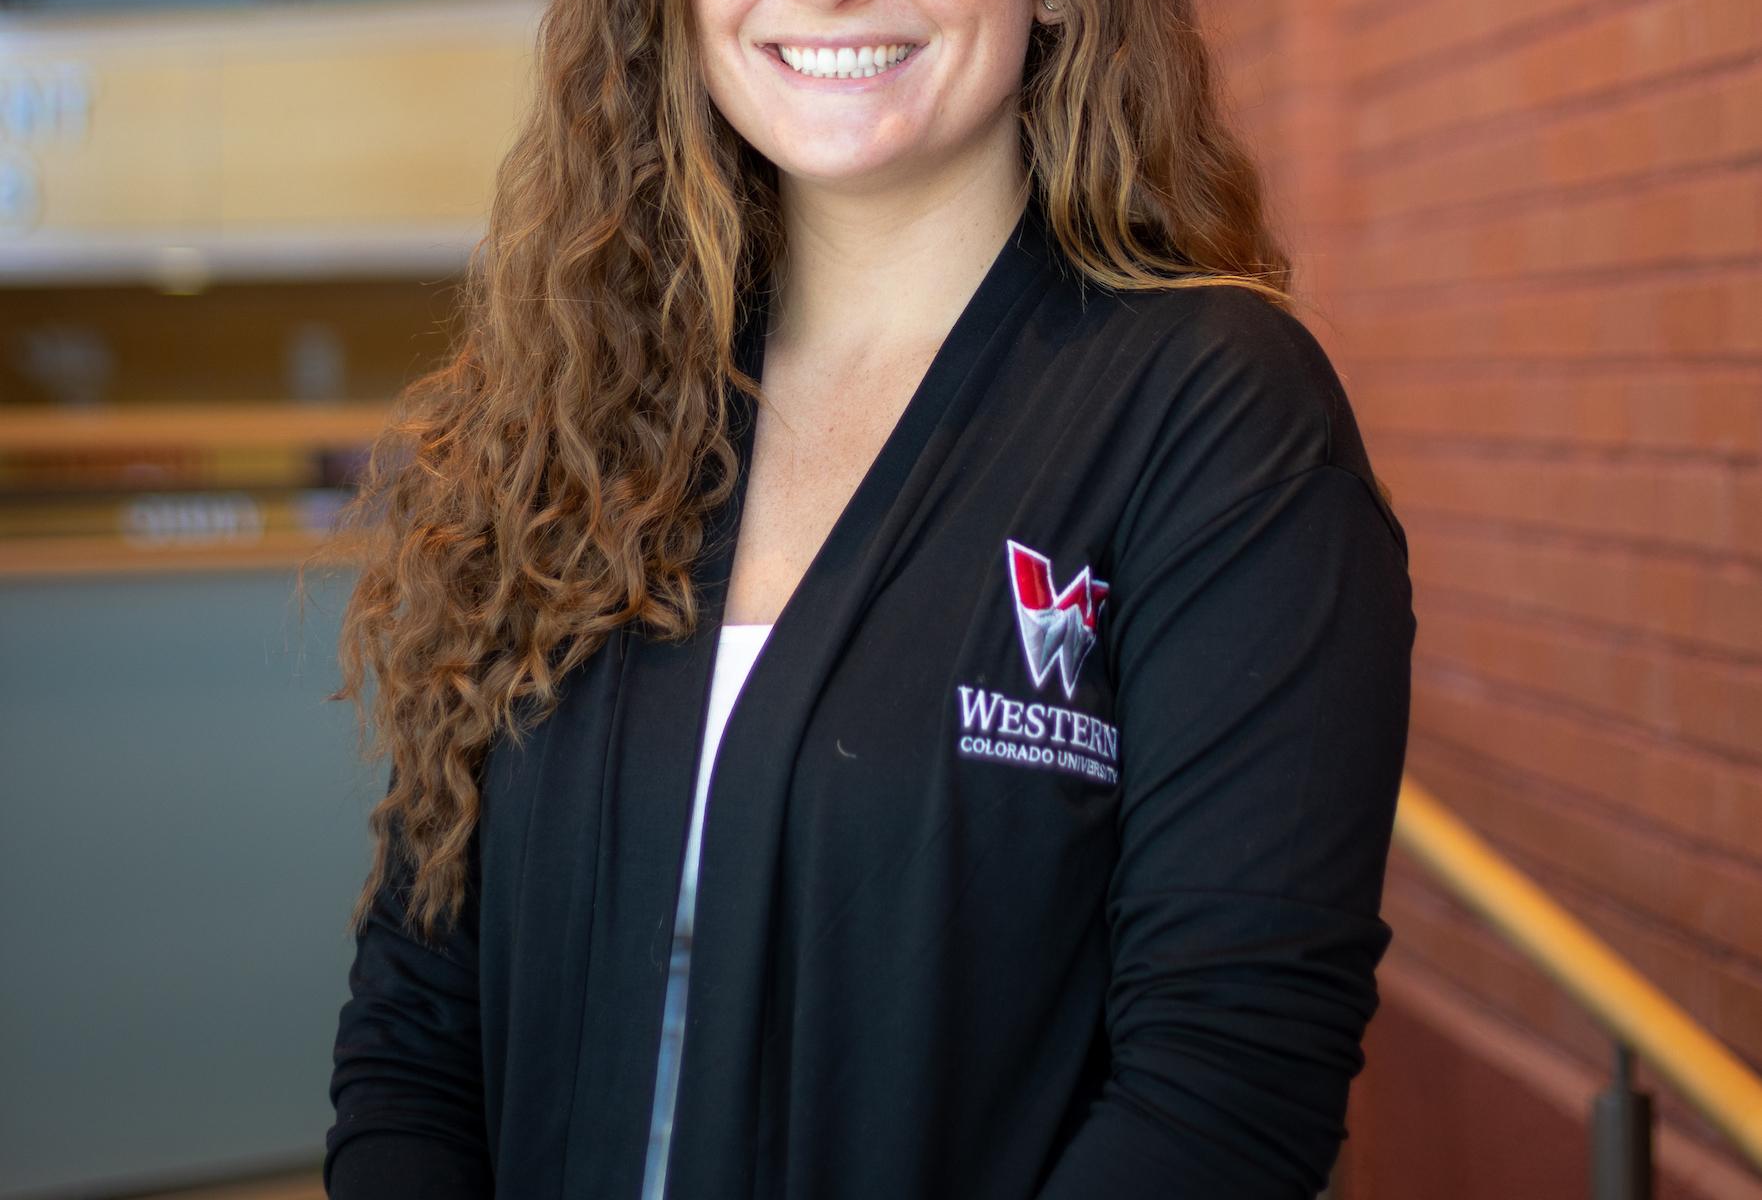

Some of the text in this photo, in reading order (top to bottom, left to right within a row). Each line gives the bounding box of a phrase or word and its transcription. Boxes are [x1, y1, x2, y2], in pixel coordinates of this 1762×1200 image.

[958, 686, 1118, 760] WESTERN
[960, 736, 1118, 784] COLORADO UNIVERSITY
